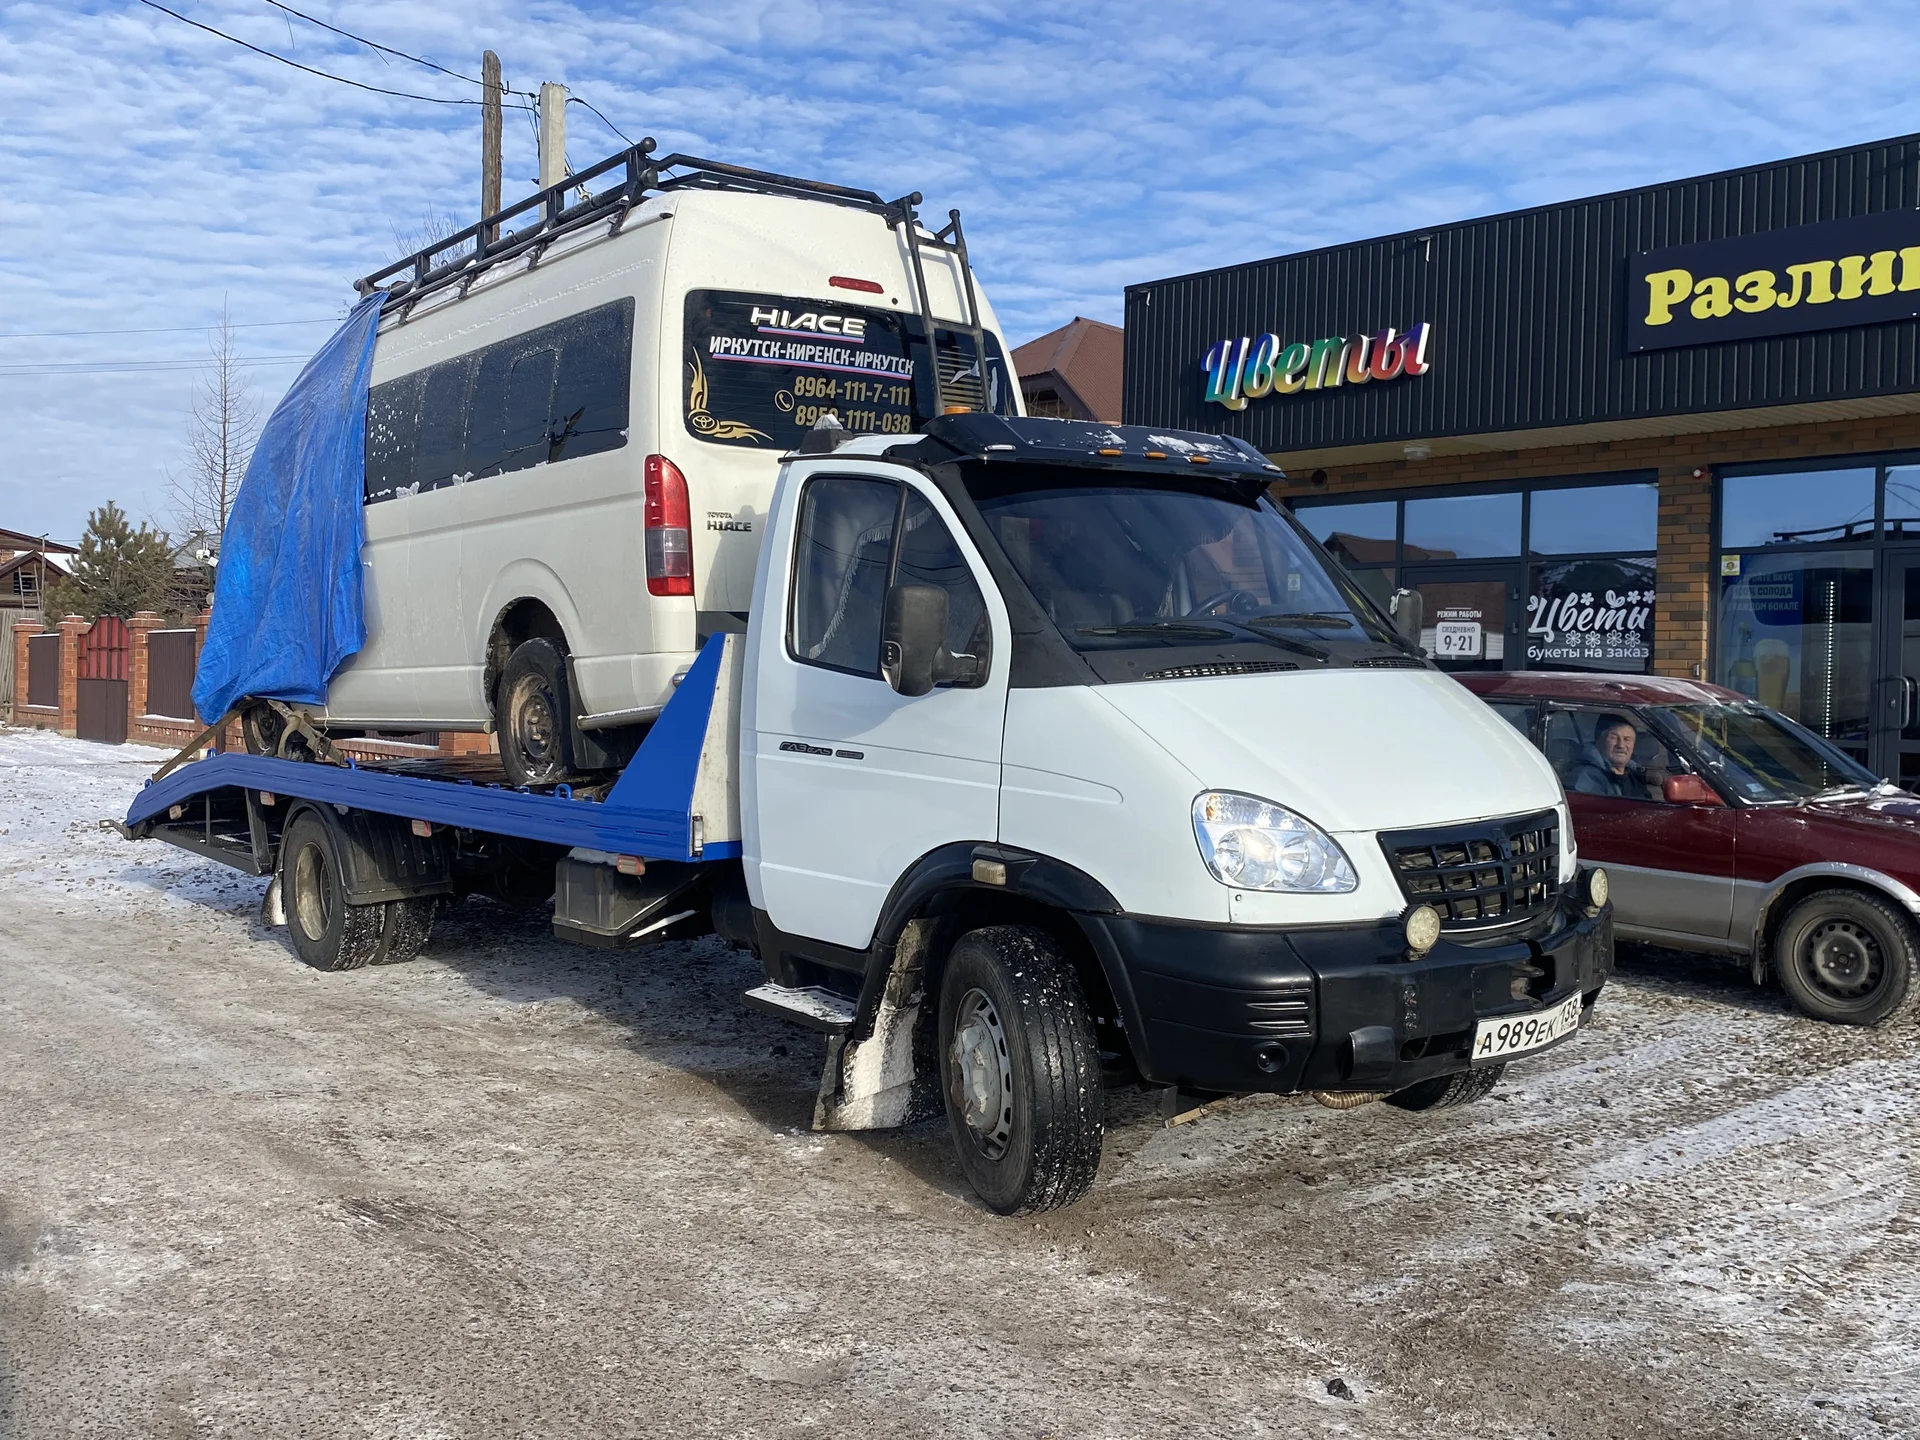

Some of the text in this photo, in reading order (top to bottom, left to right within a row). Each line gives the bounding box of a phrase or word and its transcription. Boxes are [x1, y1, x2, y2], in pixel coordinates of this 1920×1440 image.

[751, 307, 867, 336] HIACE
[709, 336, 914, 375] ИРКУТСК-КИРЕНСК-ИРКУТСК
[1201, 322, 1430, 411] Цветы
[794, 376, 910, 406] 8964-111-7-111
[707, 511, 733, 519] TOYOTA
[707, 520, 752, 532] HIACE
[1757, 586, 1793, 597] СОЛОДА
[1768, 601, 1799, 611] БОКАЛЕ
[1528, 592, 1650, 643] Цветы
[1444, 635, 1473, 651] 9-21
[1527, 645, 1650, 661] букеты на заказ
